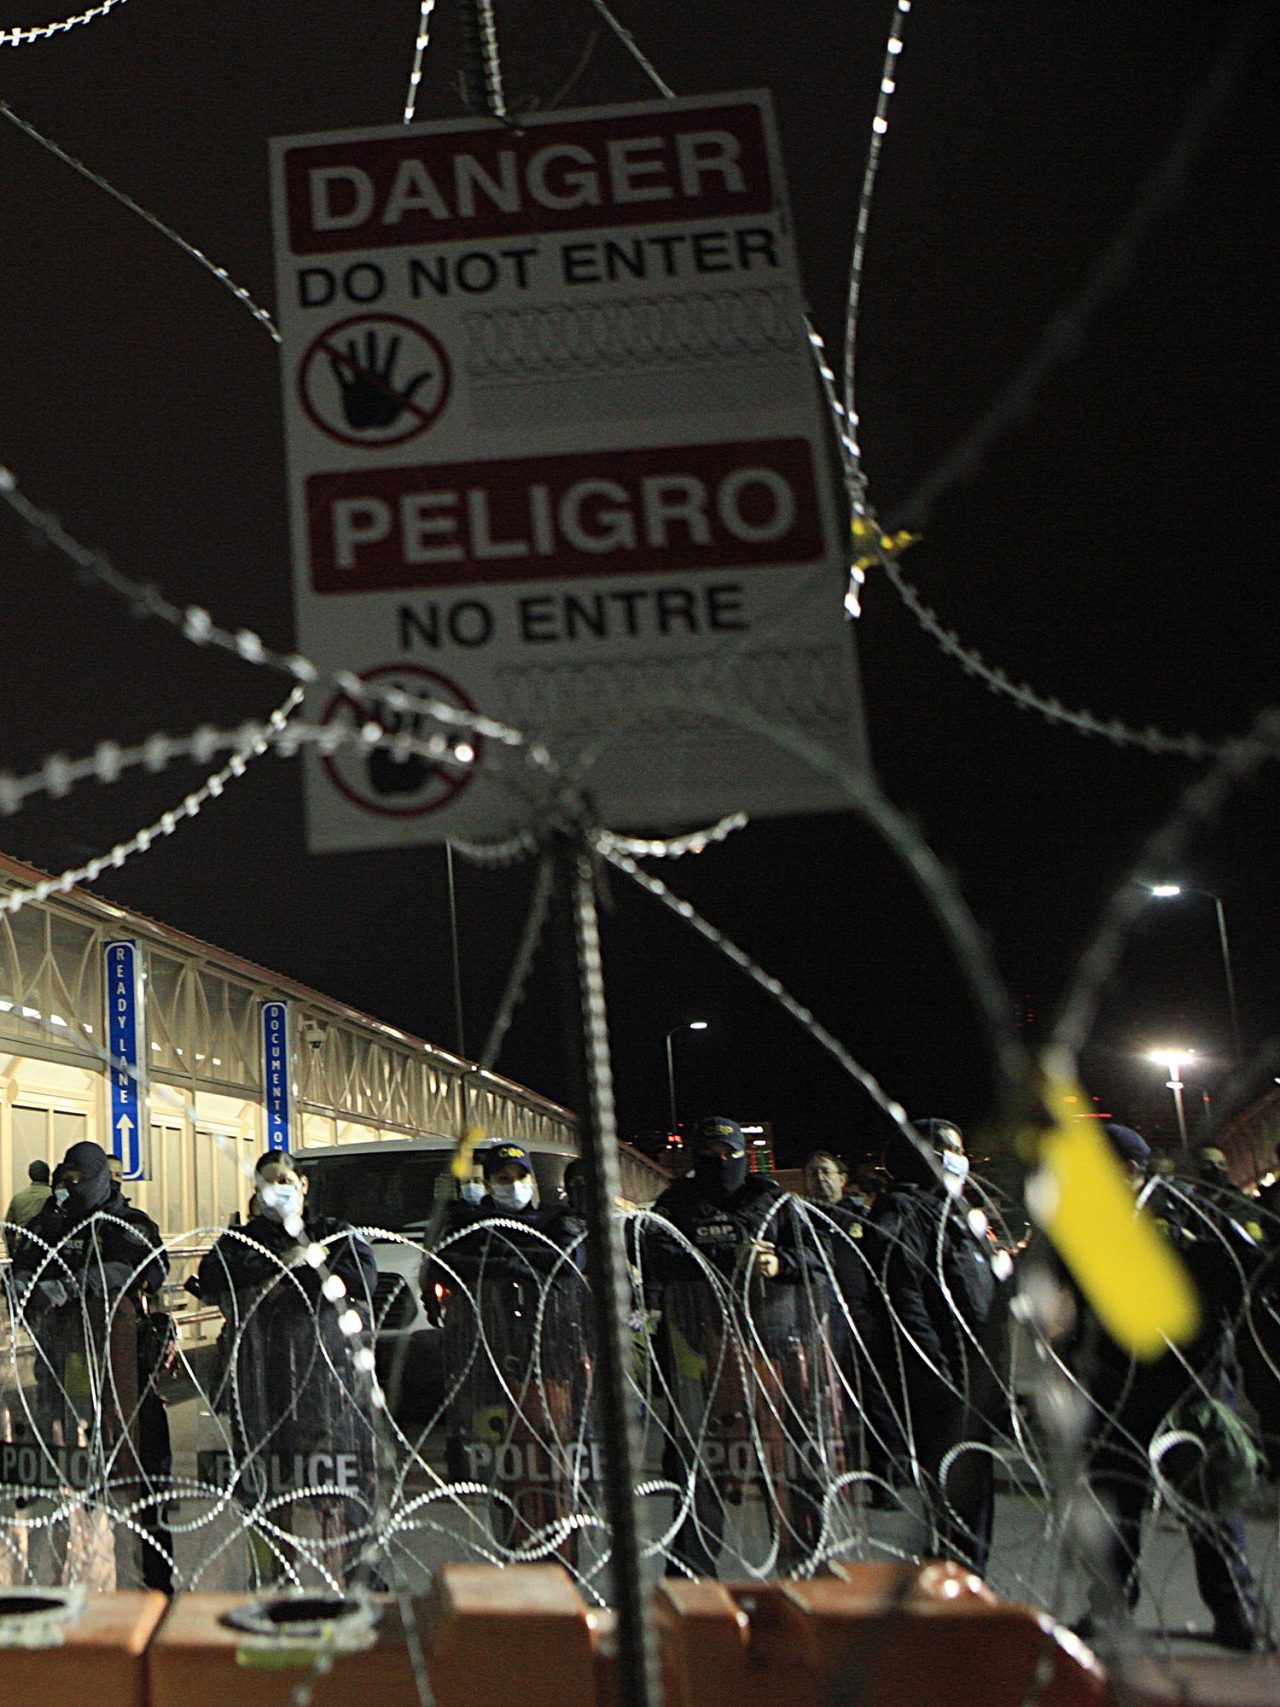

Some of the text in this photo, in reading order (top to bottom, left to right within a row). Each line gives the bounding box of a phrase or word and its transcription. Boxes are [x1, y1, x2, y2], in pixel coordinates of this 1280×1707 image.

[308, 130, 749, 232] DANGER
[297, 227, 781, 310] DO NOT ENTER
[332, 467, 797, 569] PELIGRO
[397, 584, 751, 651] NO ENTRE
[116, 948, 129, 1104] READY LANE
[270, 1007, 282, 1125] DOCUMENTS
